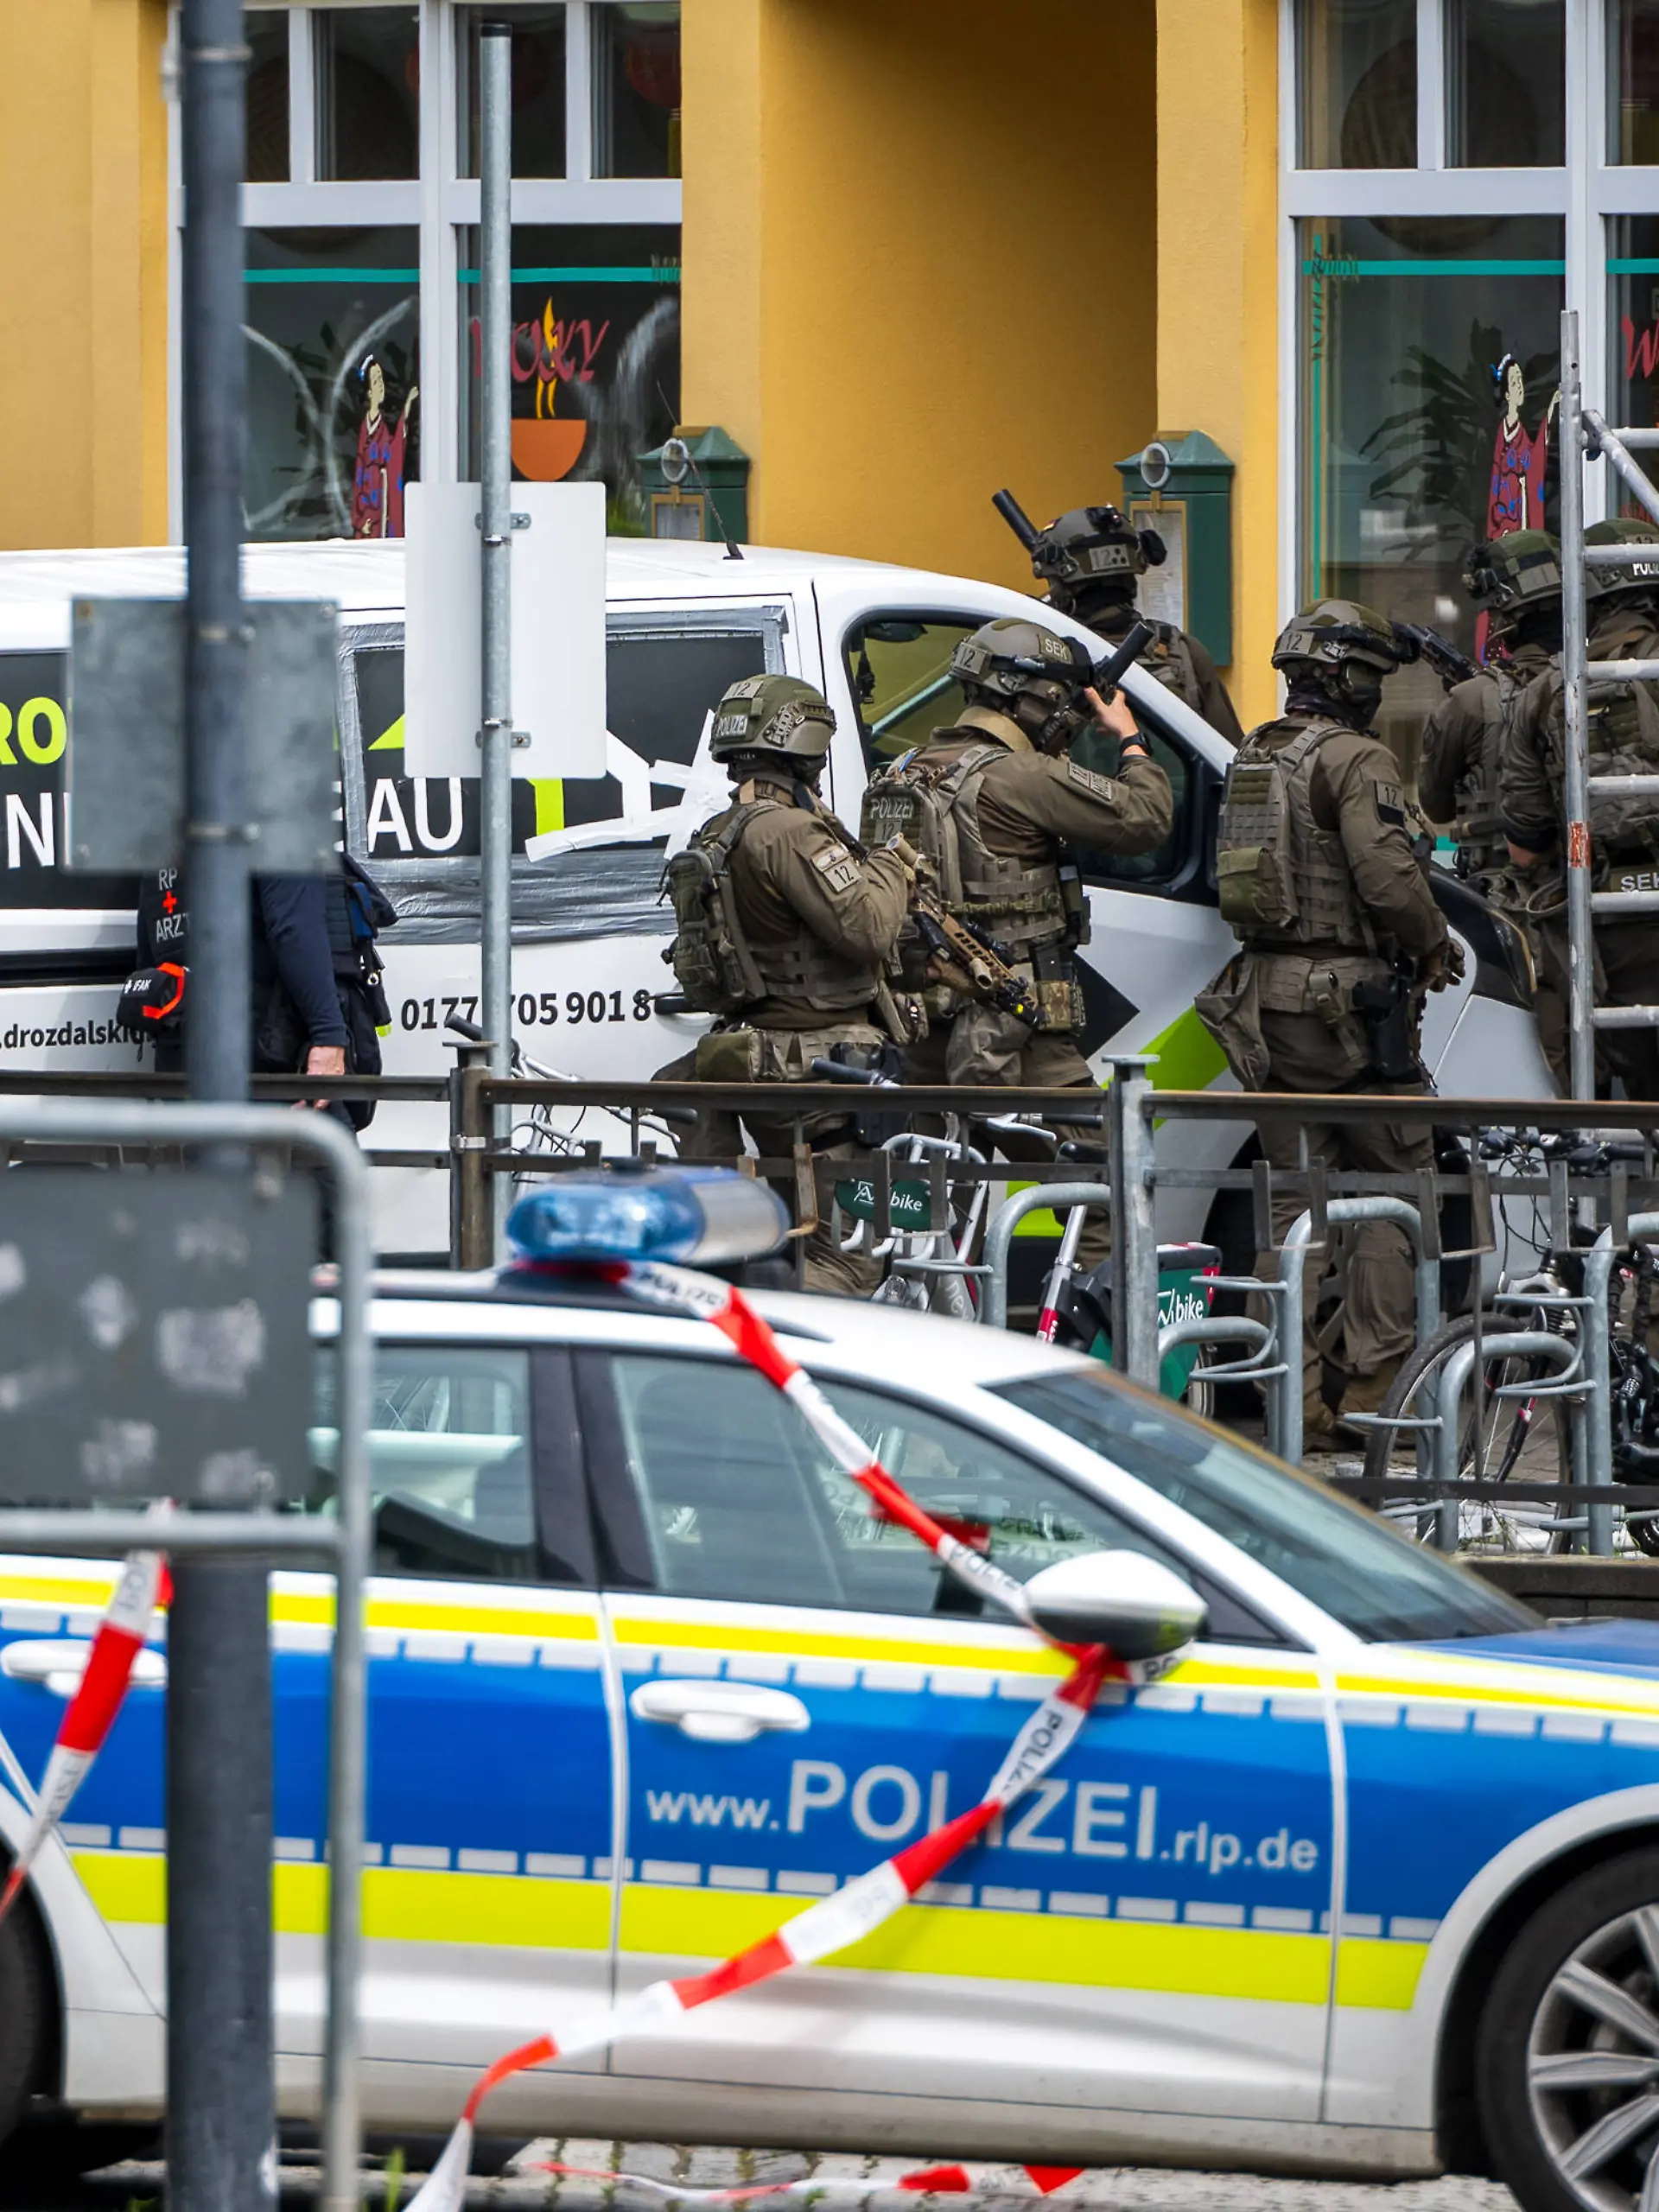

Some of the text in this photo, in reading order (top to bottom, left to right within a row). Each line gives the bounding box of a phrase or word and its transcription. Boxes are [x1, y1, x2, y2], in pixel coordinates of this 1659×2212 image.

[1045, 638, 1068, 660] SEK
[869, 797, 914, 819] POLIZEI
[158, 868, 178, 891] RP
[834, 865, 855, 884] 12
[510, 993, 558, 1026] 05
[1175, 1293, 1205, 1325] bike
